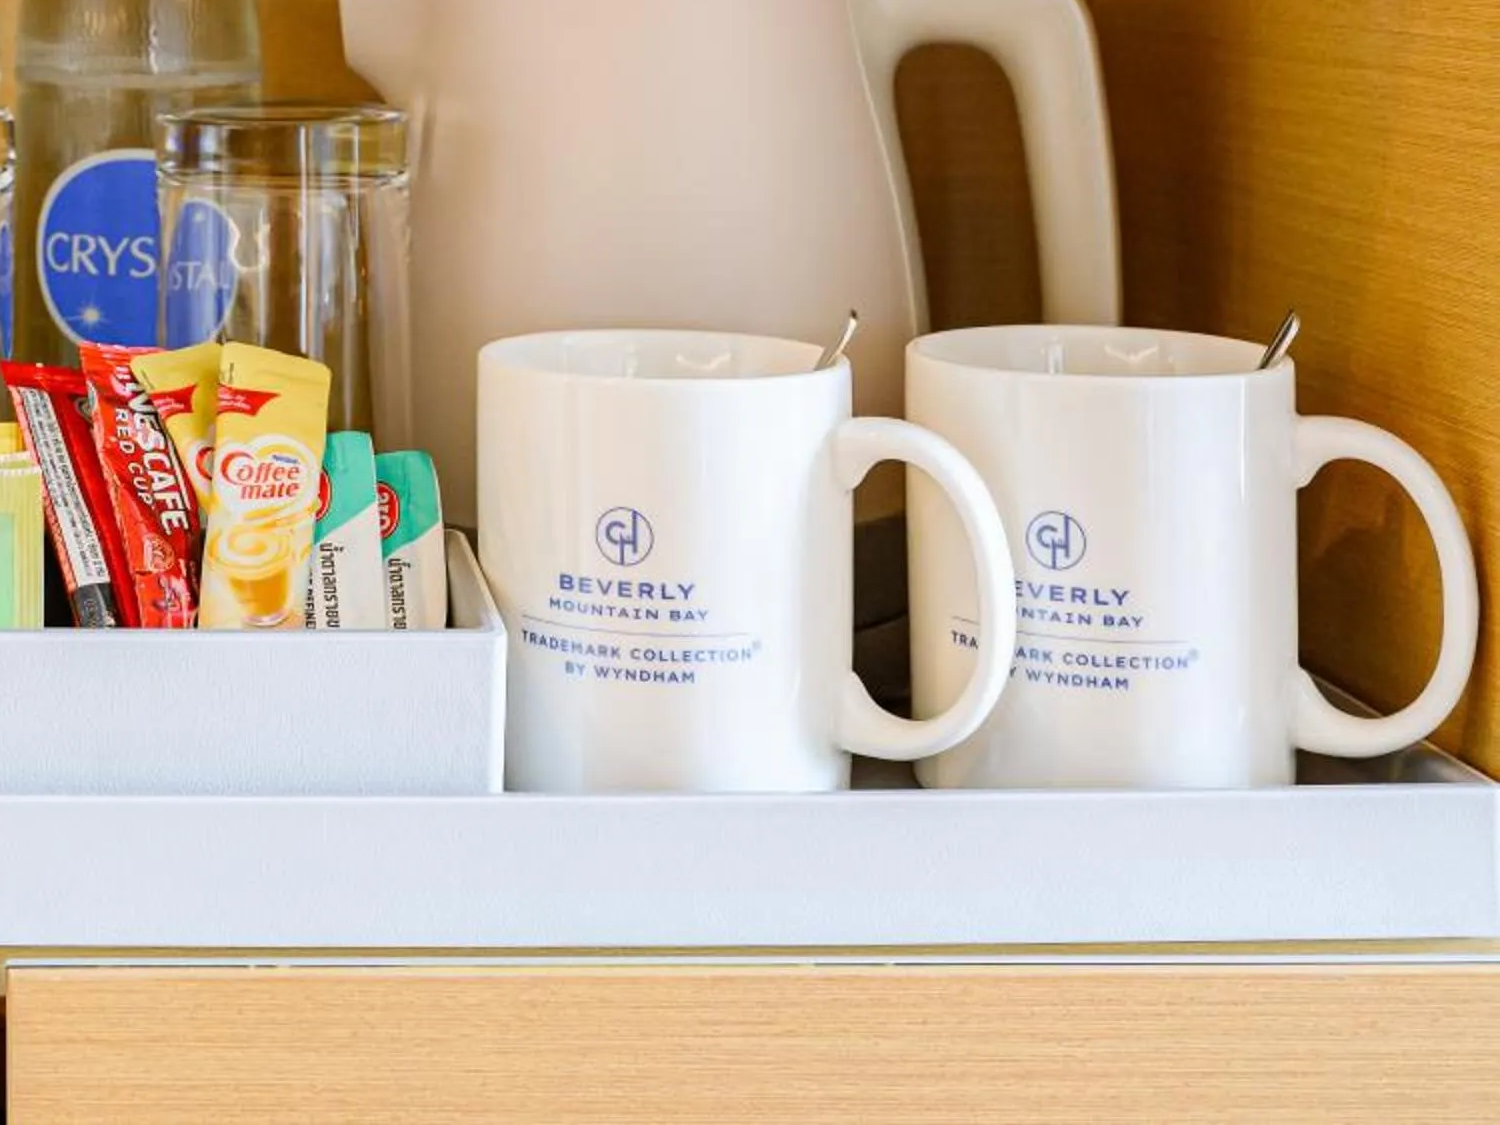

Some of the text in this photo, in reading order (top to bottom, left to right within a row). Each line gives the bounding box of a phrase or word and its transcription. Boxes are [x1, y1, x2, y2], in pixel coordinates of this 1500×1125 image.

[115, 407, 154, 506] RED CUP
[220, 448, 300, 486] Coffee
[240, 482, 300, 500] mate
[559, 572, 696, 601] BEVERLY
[1015, 580, 1131, 606] EVERLY
[549, 596, 709, 623] MOUNTAIN BAY
[1016, 606, 1145, 628] NTAIN BAY
[522, 629, 622, 660] TRADEMARK
[565, 661, 696, 684] BY WYNDHAM
[1025, 668, 1130, 690] WYNDHAM
